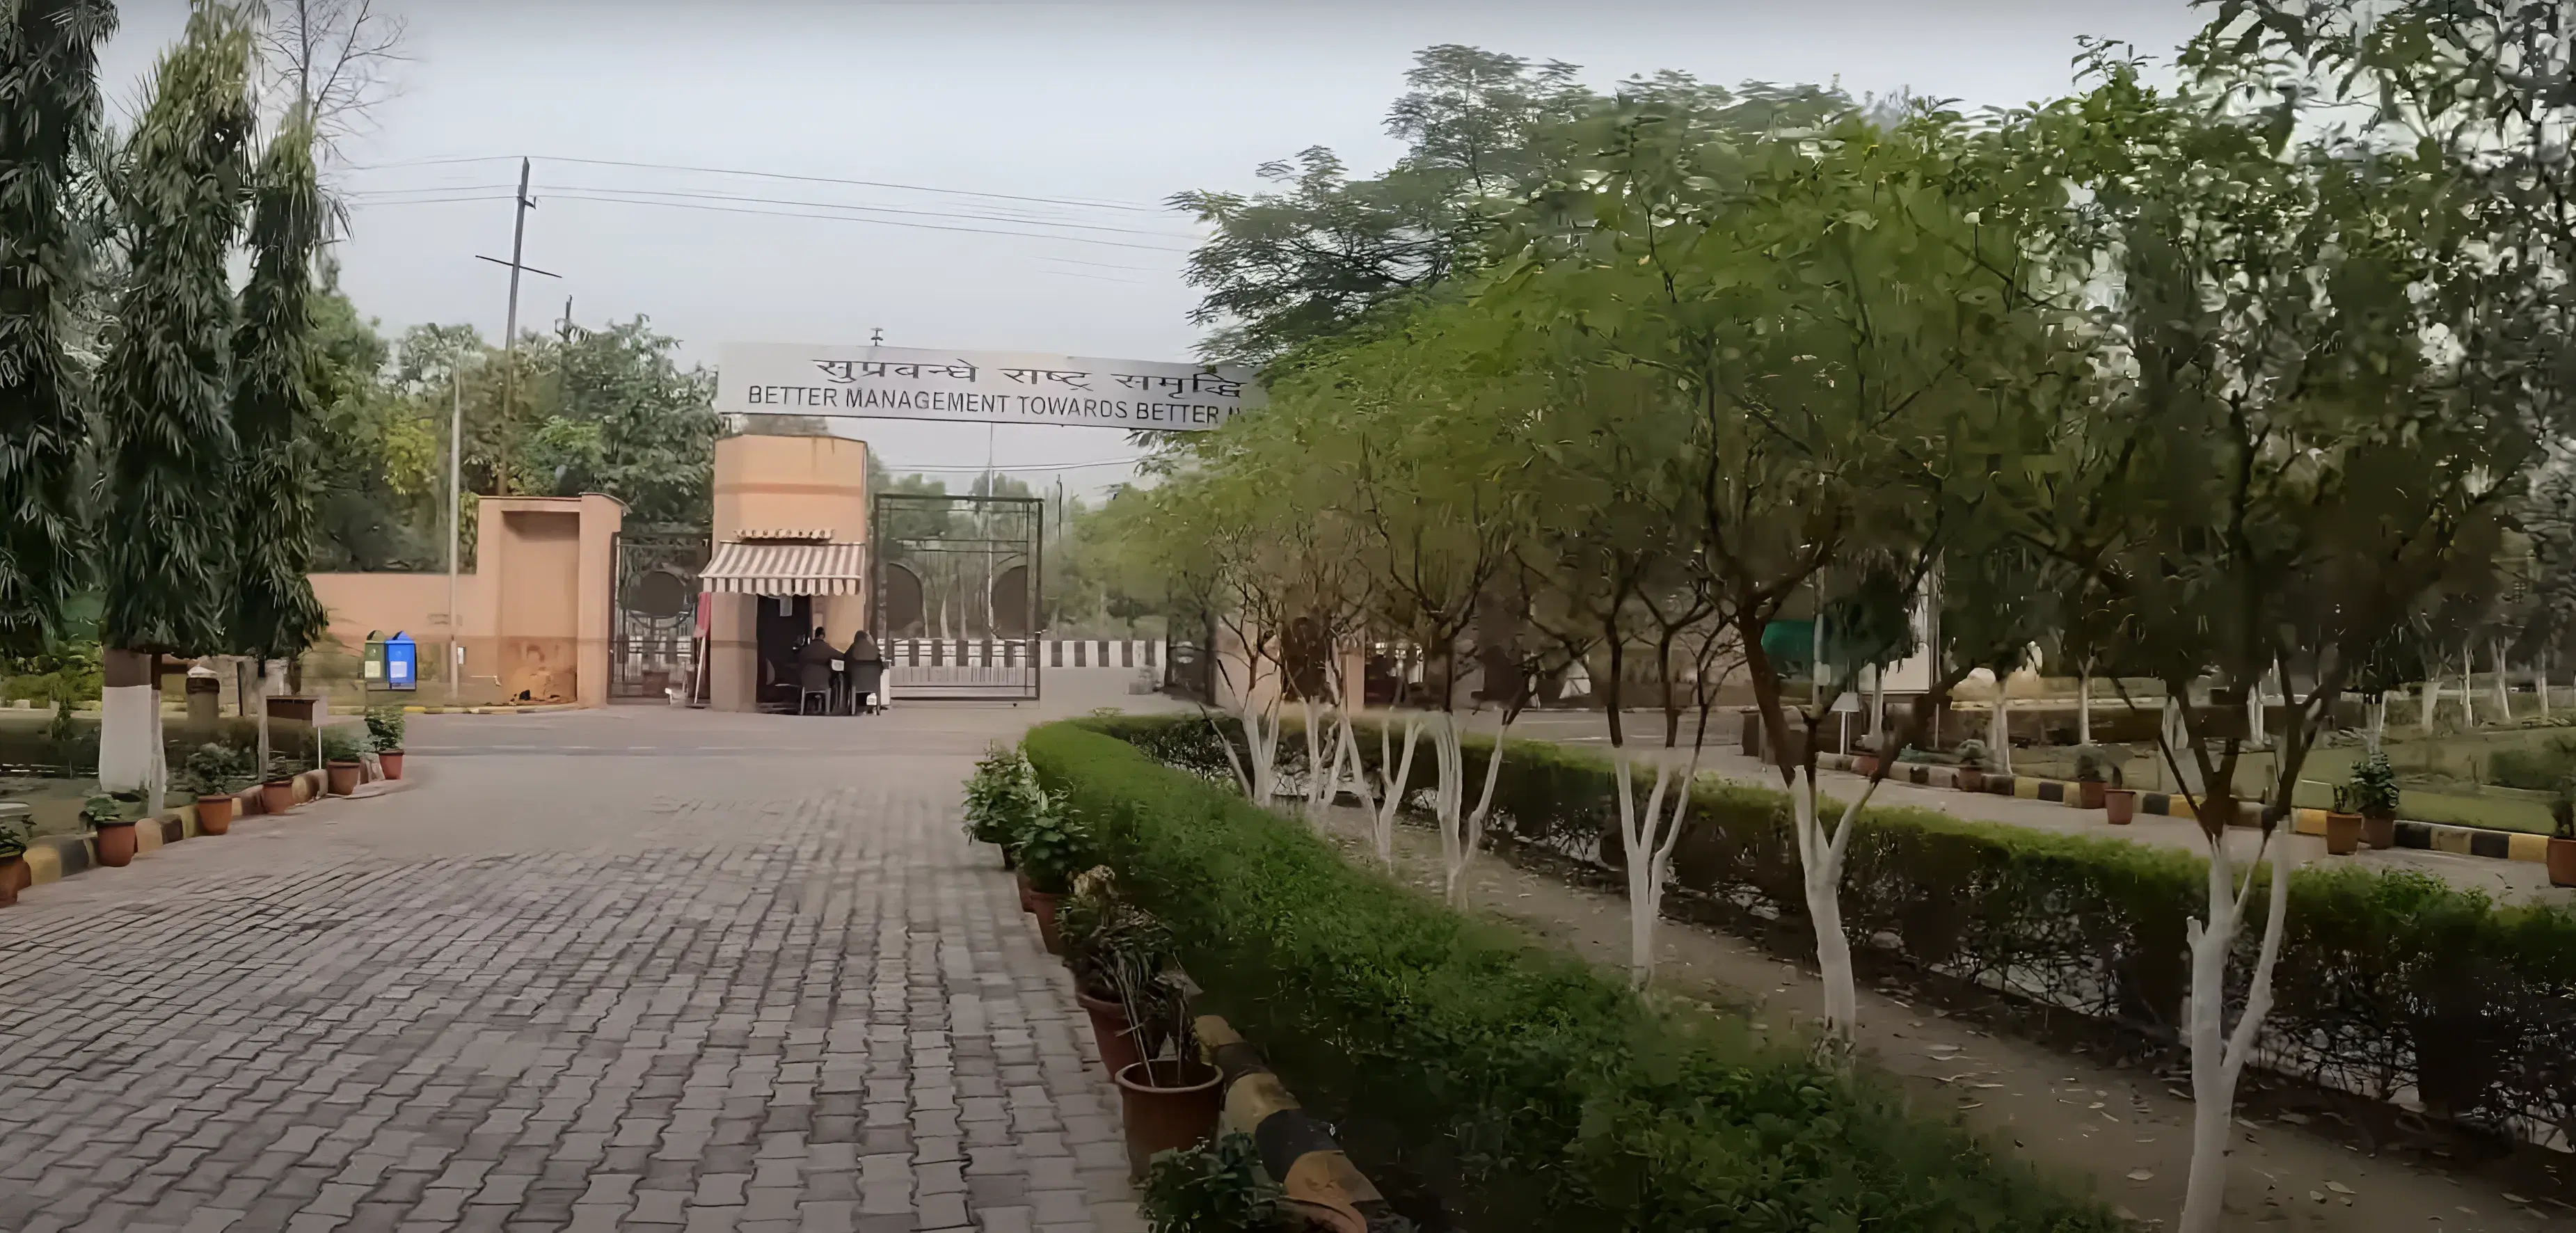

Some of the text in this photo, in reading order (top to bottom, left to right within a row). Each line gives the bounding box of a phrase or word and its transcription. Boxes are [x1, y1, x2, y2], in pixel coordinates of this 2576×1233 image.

[748, 385, 838, 408] BETTER
[845, 387, 1010, 413] MANAGEMENT
[1017, 395, 1128, 418] TOWARDS
[1136, 401, 1219, 424] BETTER
